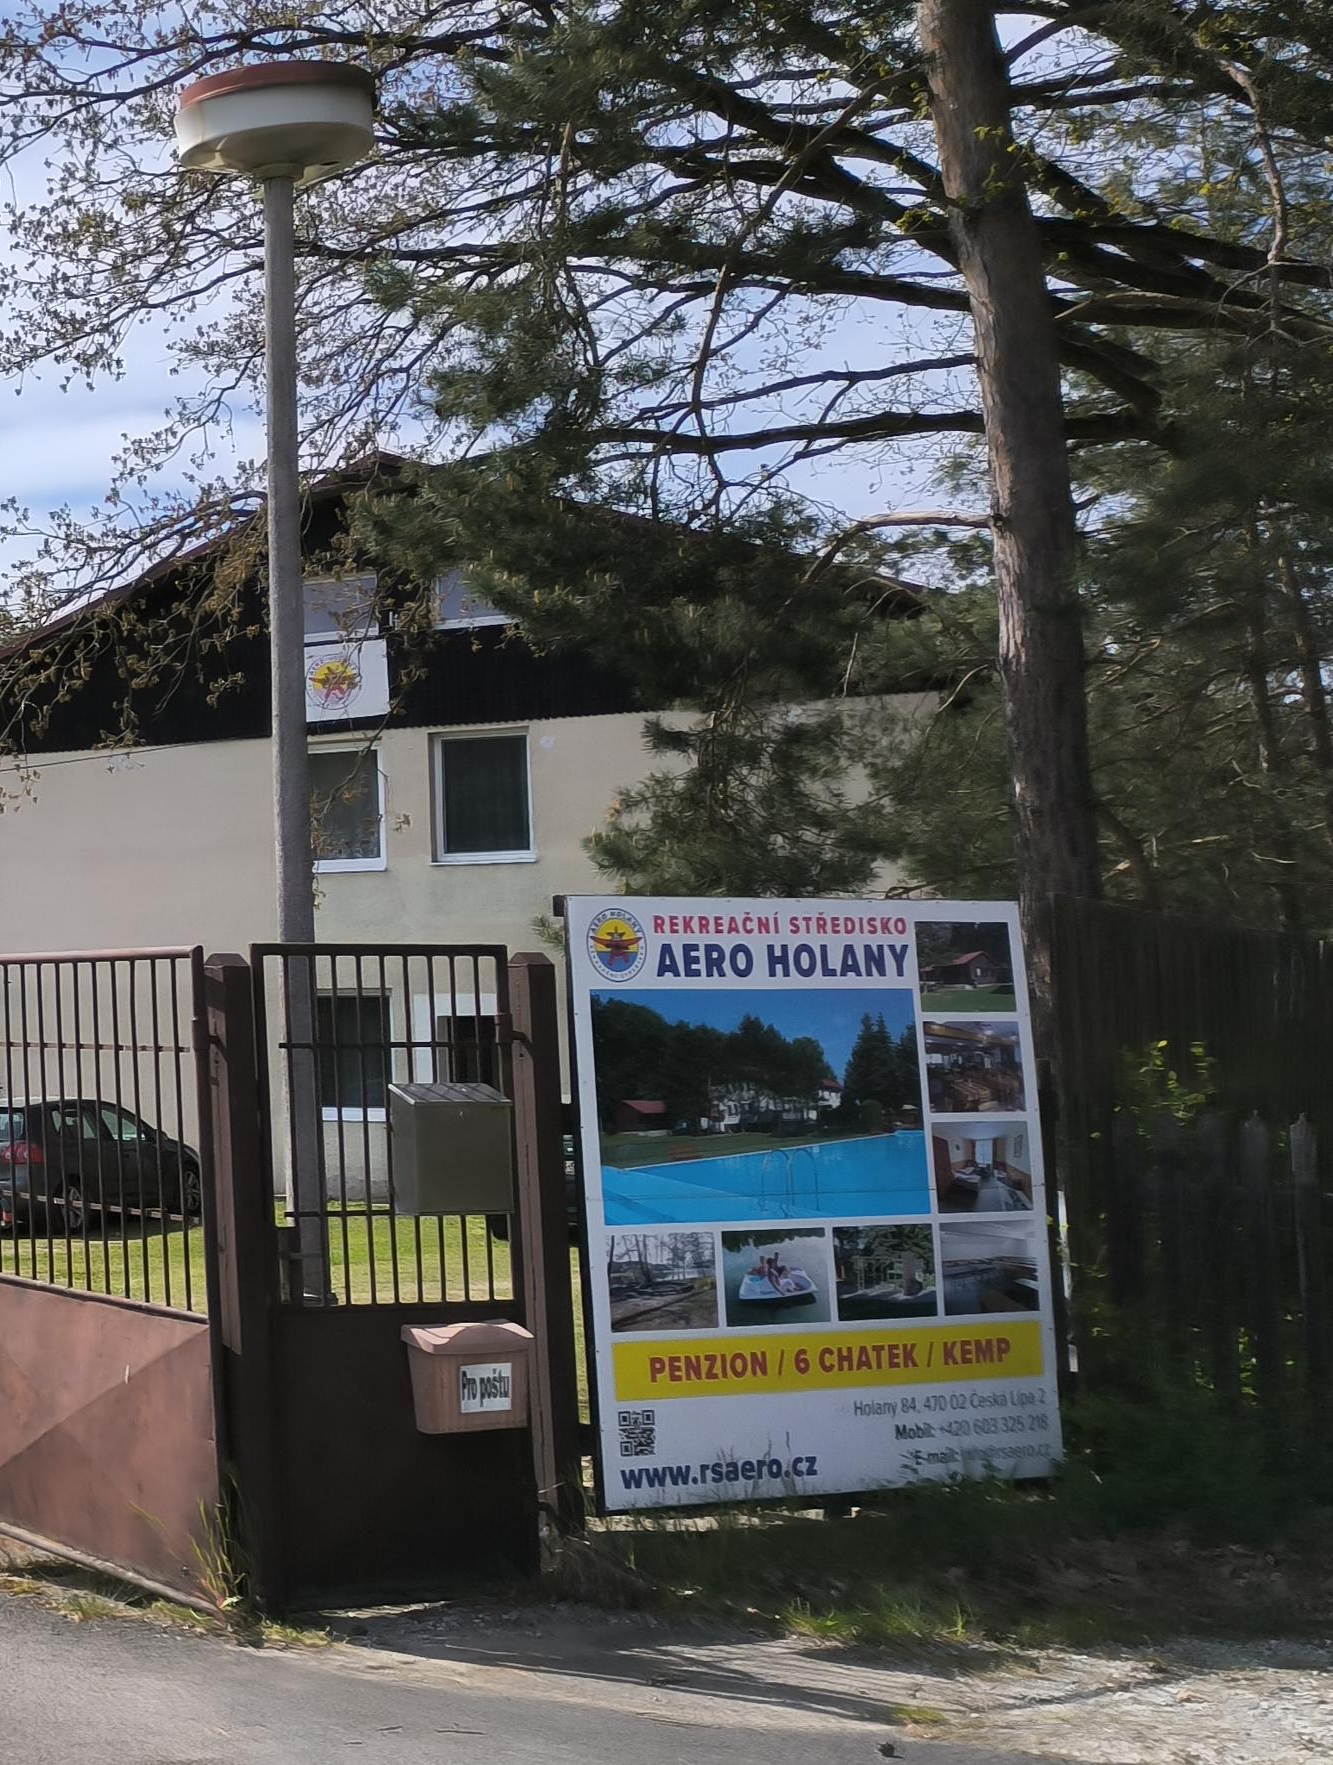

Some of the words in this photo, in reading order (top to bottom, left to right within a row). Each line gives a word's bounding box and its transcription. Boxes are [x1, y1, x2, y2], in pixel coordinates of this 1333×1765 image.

[653, 911, 780, 935] REKREAČNÍ
[789, 912, 908, 936] STŘEDISKO
[657, 943, 754, 978] AERO
[767, 943, 909, 978] HOLANY
[649, 1351, 767, 1382] PENZION
[794, 1348, 810, 1374] 6
[819, 1343, 917, 1373] CHATEK
[943, 1337, 1011, 1366] KEMP
[461, 1370, 478, 1401] Pro
[479, 1367, 510, 1407] poštu
[854, 1400, 897, 1417] Holany
[901, 1396, 921, 1414] 84,
[924, 1395, 947, 1411] 470
[950, 1393, 967, 1409] 02
[1038, 1387, 1046, 1404] 2
[1000, 1415, 1025, 1433] 325
[620, 1454, 818, 1490] www.rsaero.cz
